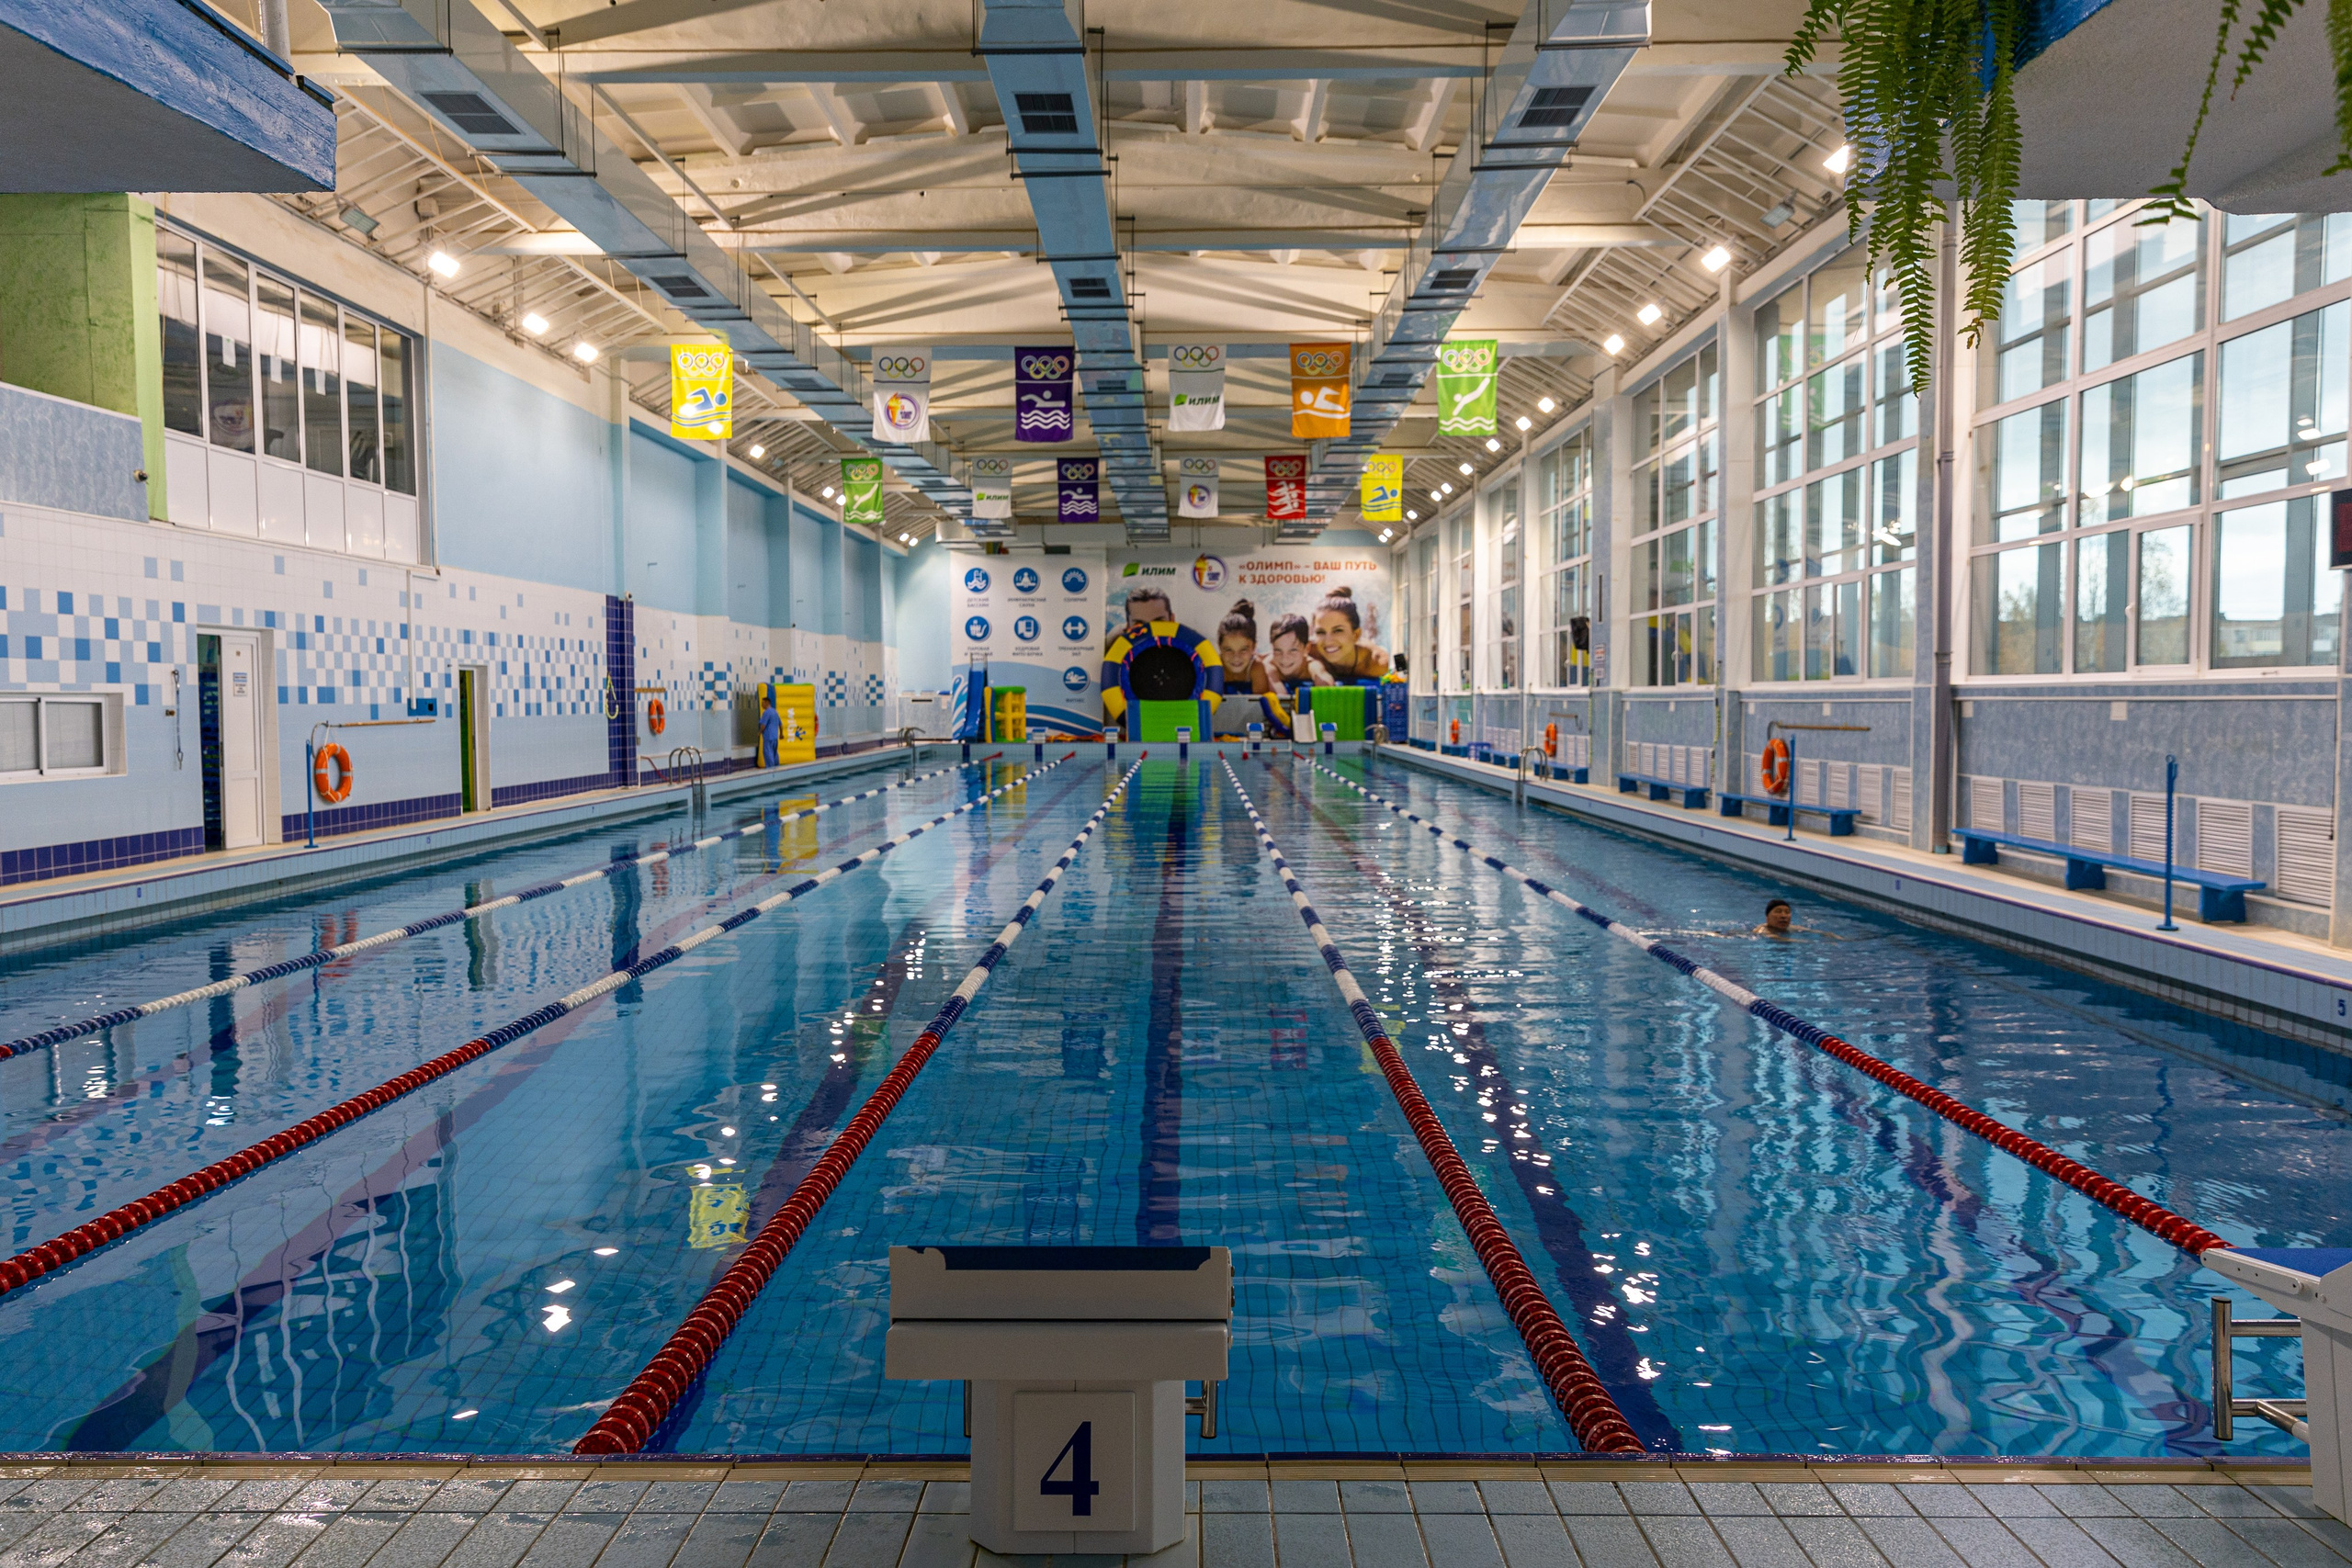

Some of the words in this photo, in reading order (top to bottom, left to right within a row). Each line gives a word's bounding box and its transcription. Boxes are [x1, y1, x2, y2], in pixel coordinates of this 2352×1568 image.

[1188, 396, 1220, 406] ИЛИМ
[1238, 561, 1301, 570] «ОЛИМП»
[1314, 561, 1341, 570] ВАШ
[1345, 561, 1377, 570] ПУТЬ
[1141, 567, 1176, 576] ИЛИМ
[1238, 574, 1247, 584] К
[1250, 574, 1326, 585] ЗДОРОВЬЮ!
[2338, 998, 2346, 1017] 5
[1040, 1421, 1099, 1516] 4
